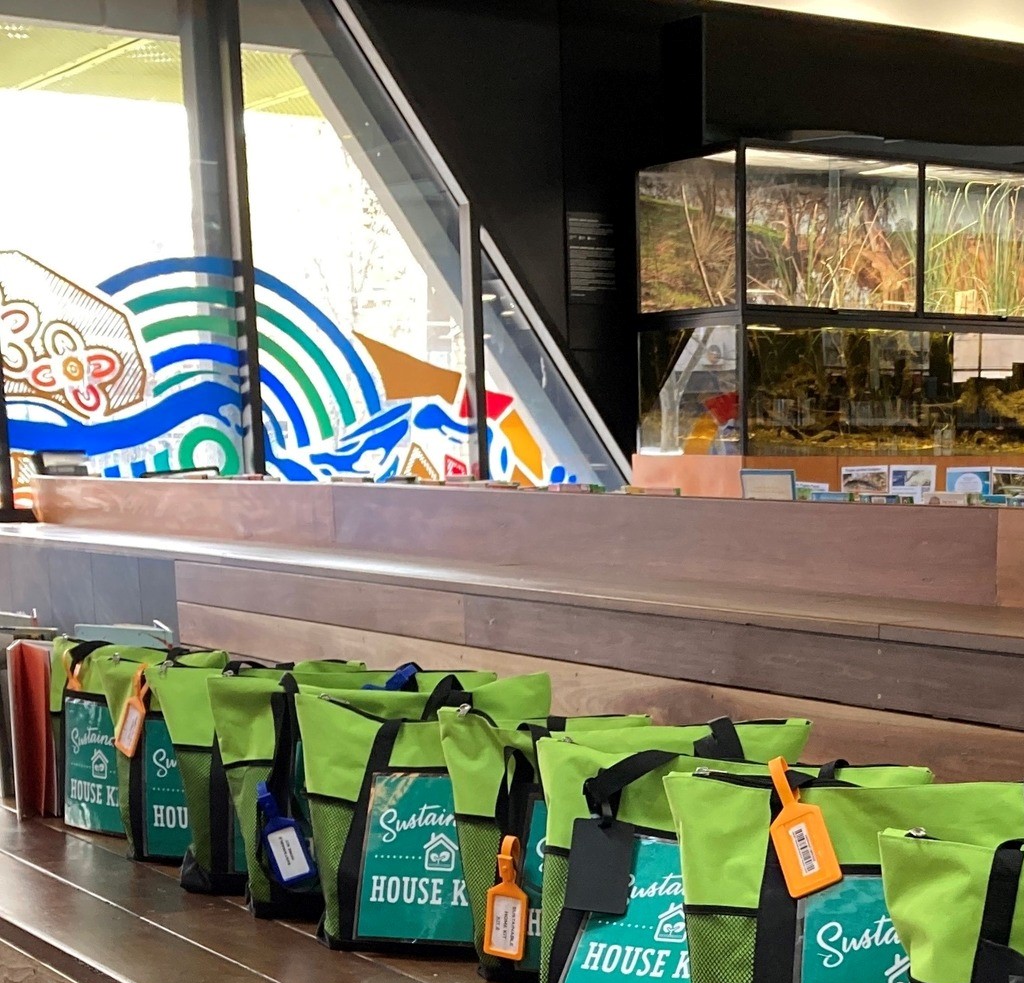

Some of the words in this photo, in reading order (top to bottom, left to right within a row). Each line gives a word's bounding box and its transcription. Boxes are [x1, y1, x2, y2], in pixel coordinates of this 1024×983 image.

[70, 778, 103, 805] HOUSE
[106, 785, 119, 807] K
[153, 804, 188, 829] HOU
[370, 875, 444, 905] HOUSE
[451, 879, 469, 907] K
[580, 941, 671, 978] HOUSE
